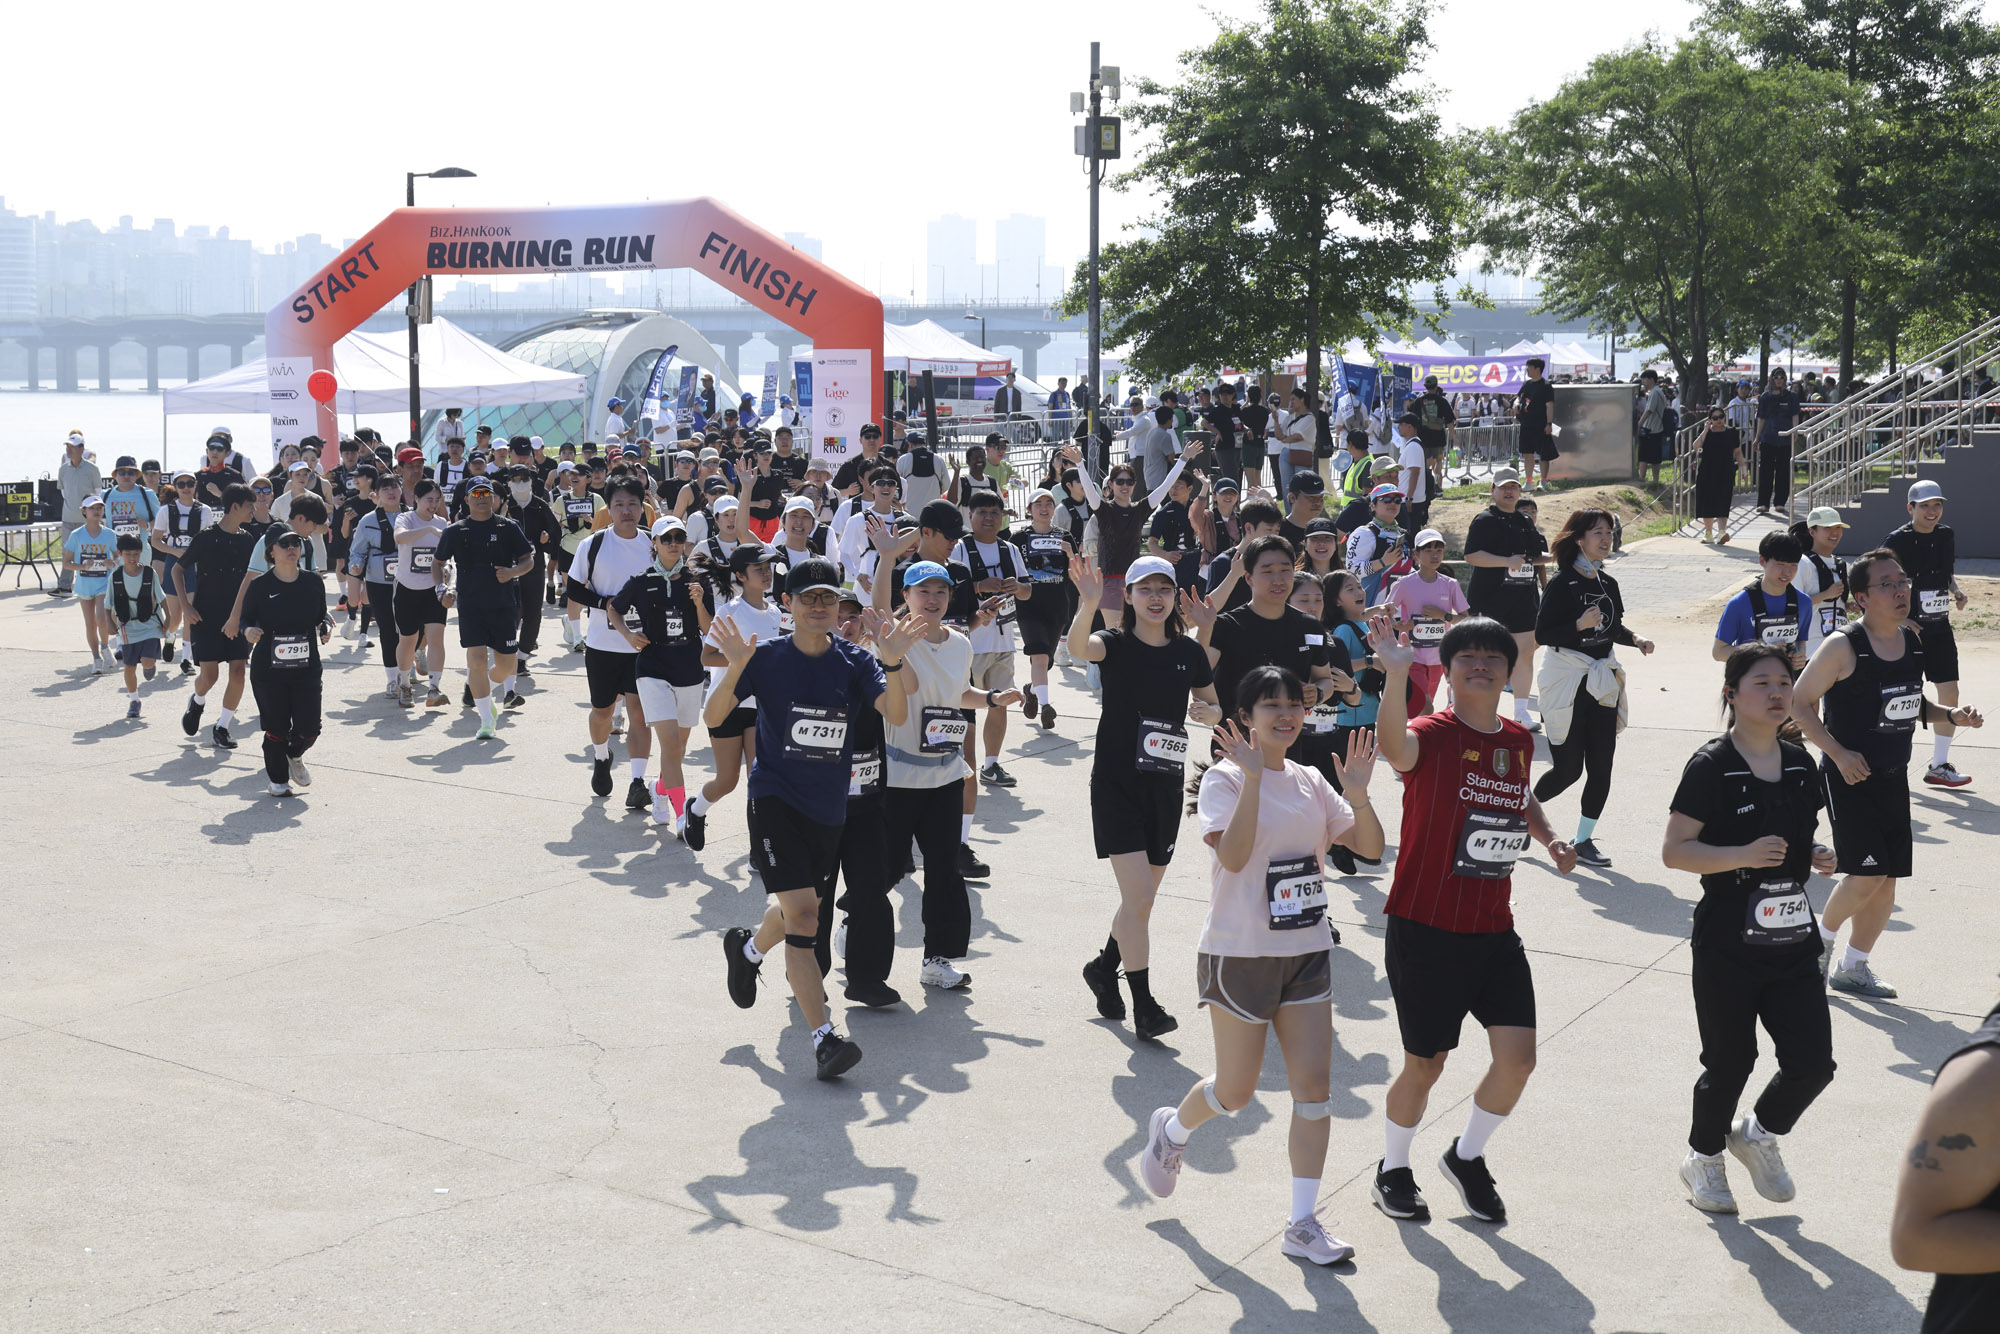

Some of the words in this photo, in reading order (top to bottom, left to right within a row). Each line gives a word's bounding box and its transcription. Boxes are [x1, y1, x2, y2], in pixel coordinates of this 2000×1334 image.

[427, 238, 573, 269] BURNING
[583, 234, 656, 266] RUN
[699, 231, 818, 316] FINISH
[292, 241, 380, 324] START
[824, 445, 847, 454] KIND
[111, 501, 137, 515] KRX
[919, 567, 944, 576] HOKA
[1933, 598, 1950, 607] 7219
[1425, 626, 1444, 634] 7696
[287, 645, 309, 654] 7913
[1900, 698, 1921, 711] 7310
[798, 727, 809, 735] M
[813, 726, 844, 738] 7311
[940, 724, 966, 735] 7869
[1150, 739, 1159, 747] W
[1161, 738, 1188, 753] 7565
[1466, 772, 1522, 795] Standard
[1459, 786, 1521, 810] Chartered
[1474, 838, 1487, 848] M
[1490, 837, 1522, 850] 7143
[1280, 888, 1291, 899] W
[1277, 902, 1297, 912] A-67
[1763, 906, 1775, 916] W
